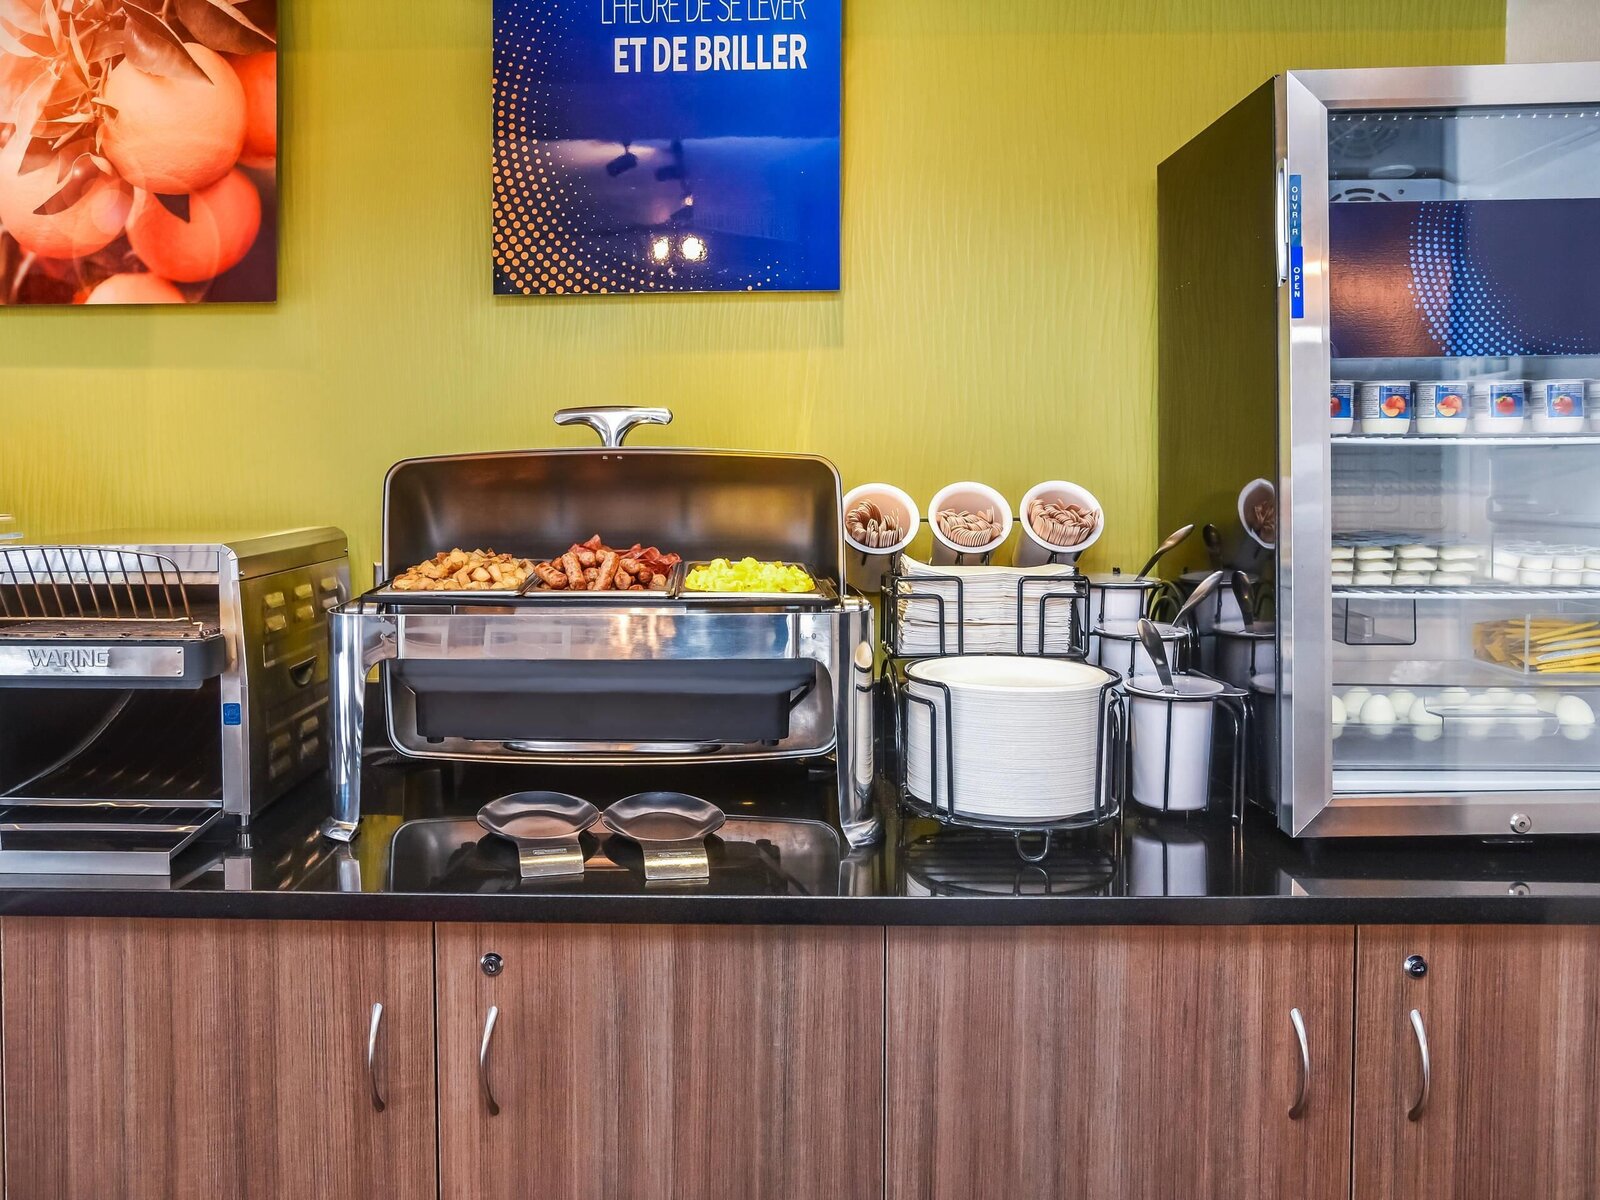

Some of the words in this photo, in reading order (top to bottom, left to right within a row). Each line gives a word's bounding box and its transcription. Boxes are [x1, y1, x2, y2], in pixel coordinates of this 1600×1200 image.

[602, 0, 680, 24] LHEURE
[686, 0, 712, 22] DE
[717, 0, 742, 21] SE
[748, 0, 807, 20] LEVER
[614, 37, 647, 73] ET
[653, 36, 688, 72] DE
[695, 34, 808, 71] BRILLER
[1291, 186, 1299, 235] OUVRIR
[1293, 267, 1301, 298] OPEN
[27, 649, 110, 673] WARING
